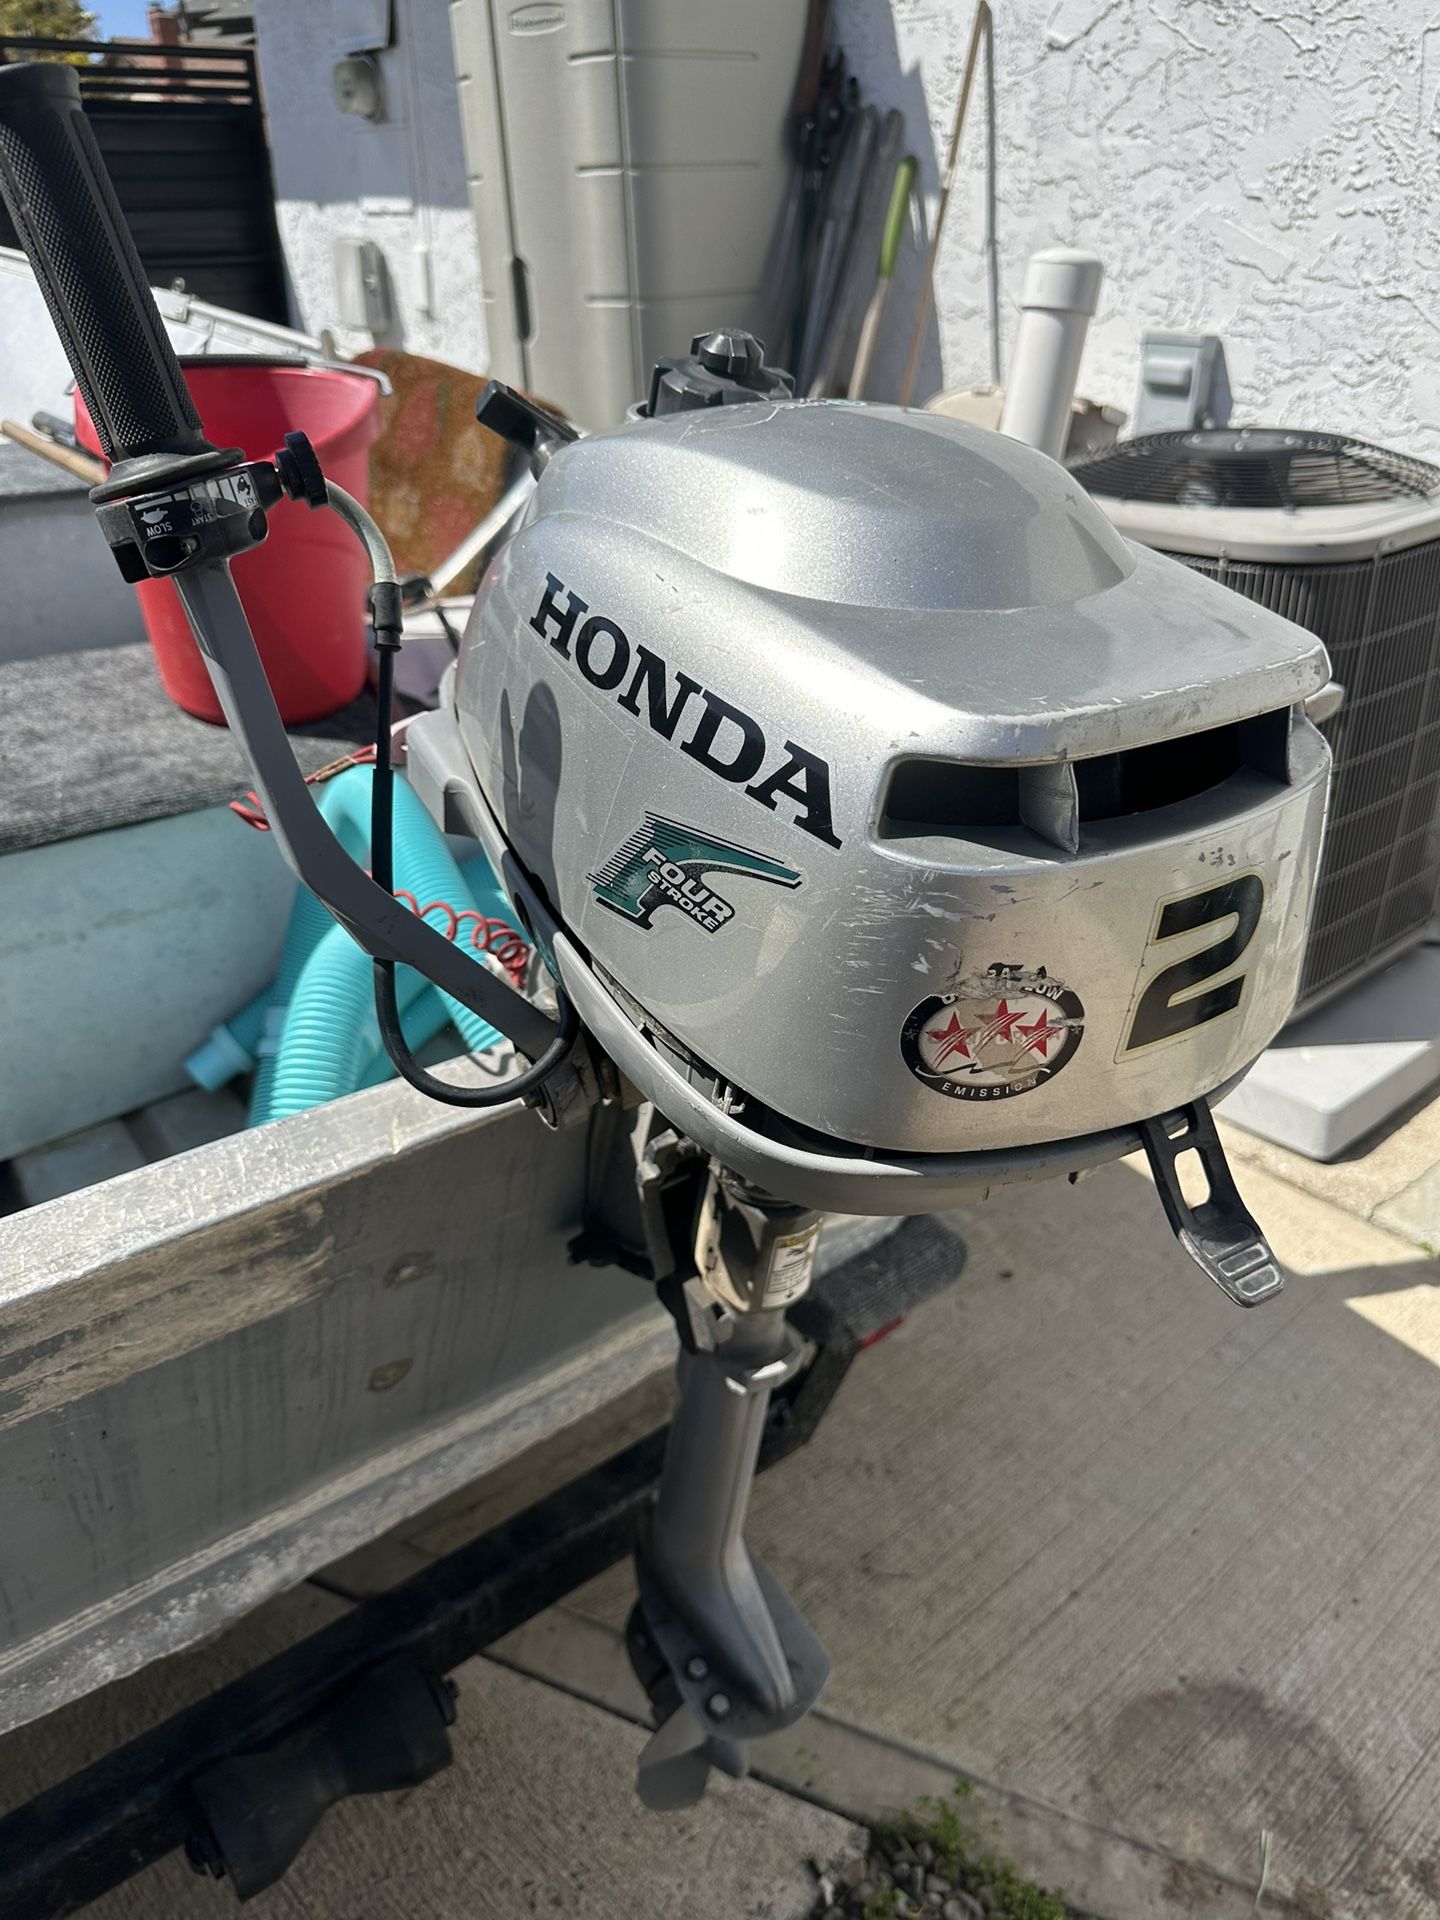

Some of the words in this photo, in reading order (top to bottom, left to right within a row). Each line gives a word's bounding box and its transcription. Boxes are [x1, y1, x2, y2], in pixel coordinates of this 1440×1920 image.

[146, 521, 173, 537] SLOW
[191, 512, 213, 526] START
[529, 571, 843, 850] HONDA
[642, 846, 734, 923] FOUR
[646, 869, 718, 931] STROKE
[1125, 874, 1264, 1051] 2
[941, 1077, 1037, 1097] EMISSION
